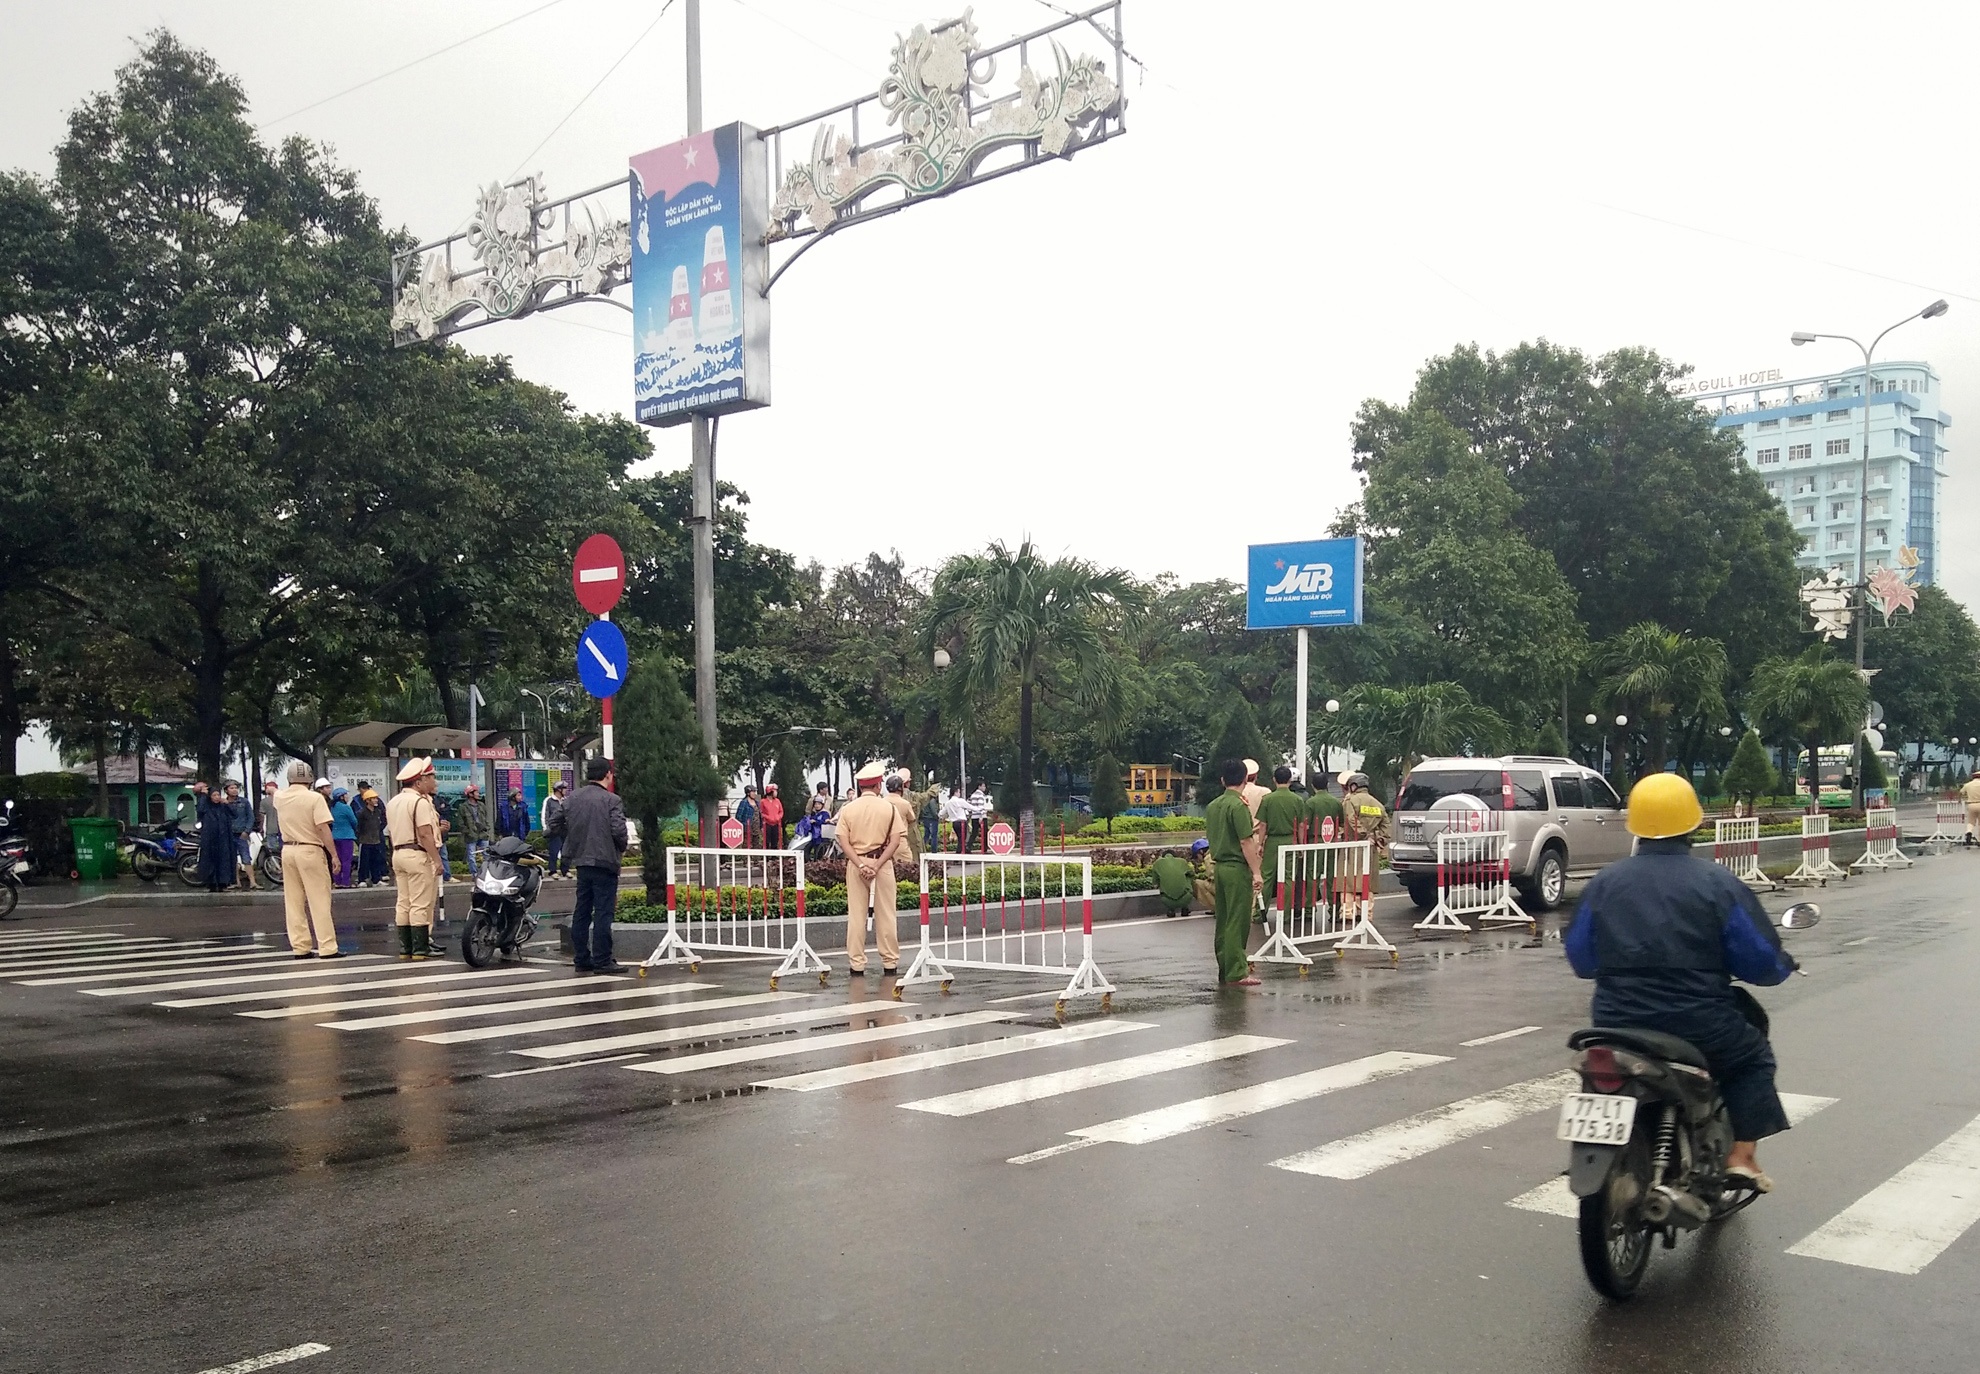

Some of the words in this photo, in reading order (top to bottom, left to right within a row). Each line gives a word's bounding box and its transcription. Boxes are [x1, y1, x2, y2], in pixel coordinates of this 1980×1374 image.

[1740, 368, 1784, 386] HOTEL
[1266, 563, 1334, 594] MB
[723, 828, 742, 838] STOP
[1322, 824, 1334, 836] STOP
[989, 832, 1013, 846] STOP
